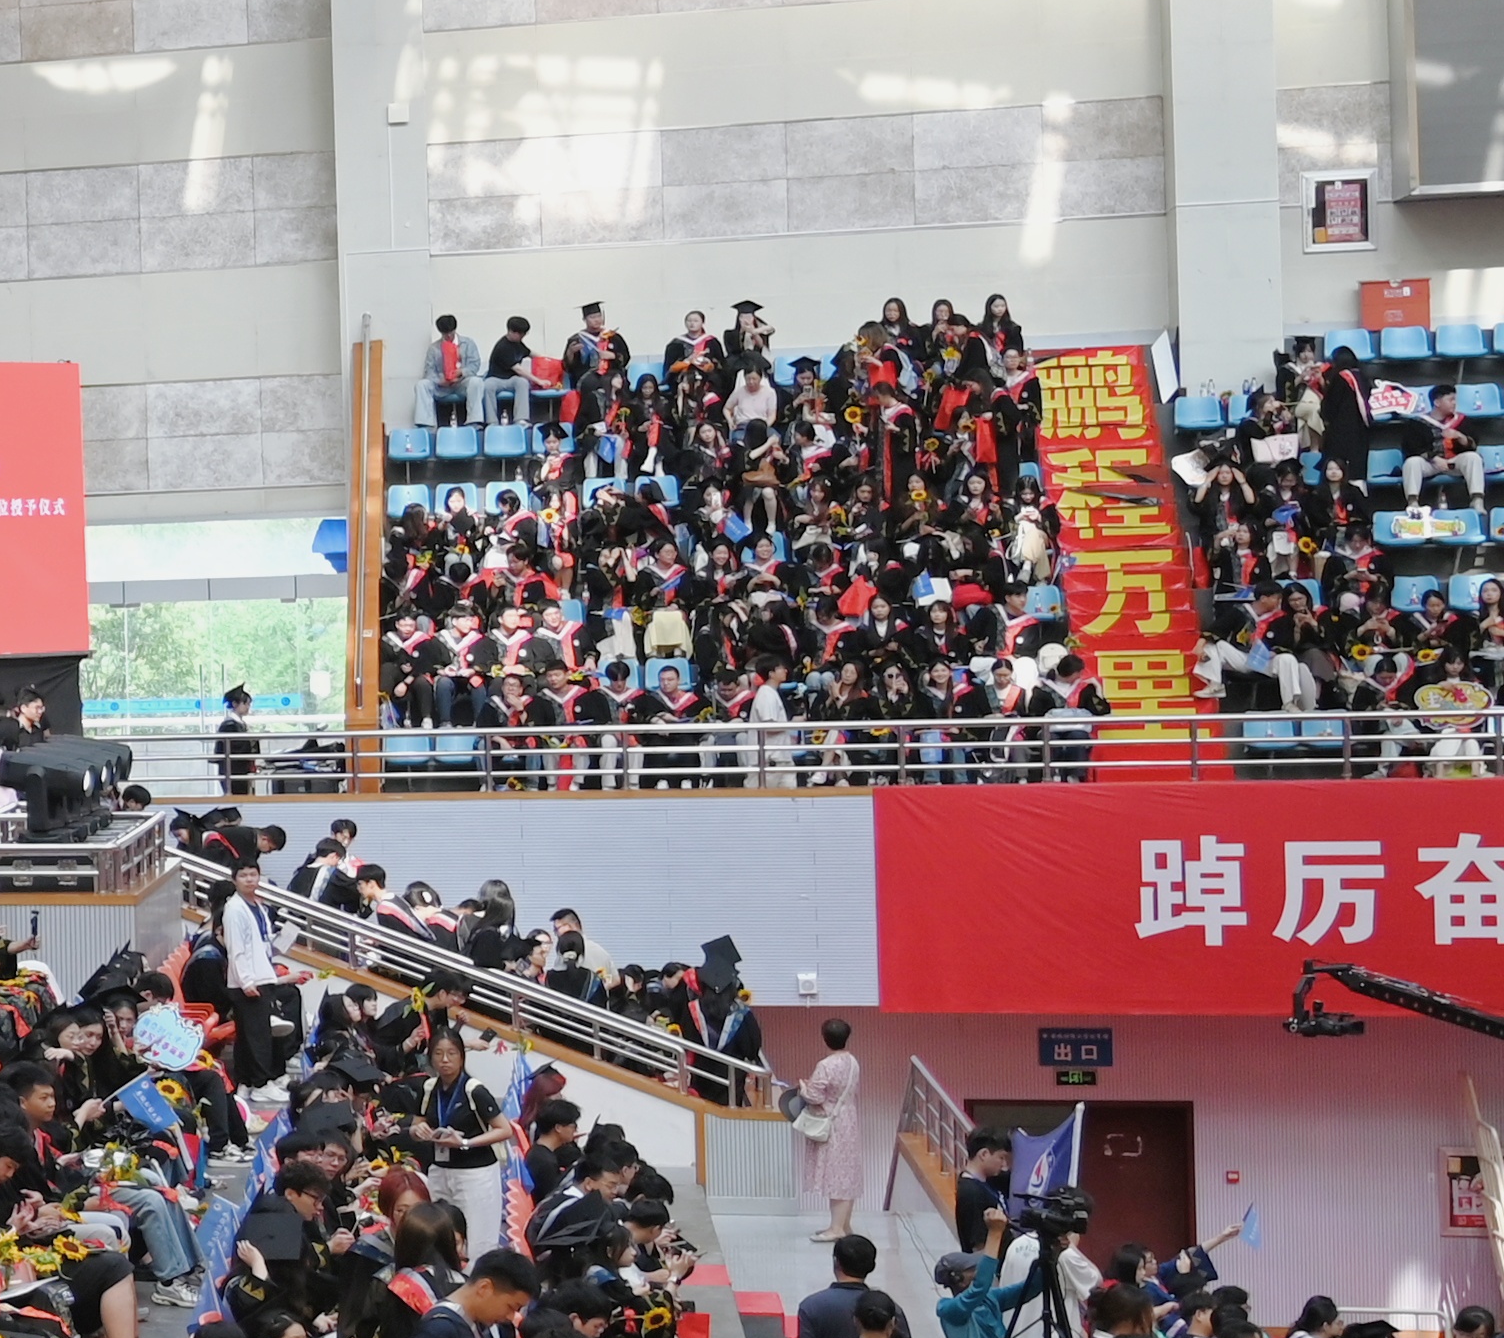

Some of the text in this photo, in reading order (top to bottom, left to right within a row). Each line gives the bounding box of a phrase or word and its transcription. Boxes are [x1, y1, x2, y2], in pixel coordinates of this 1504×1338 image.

[1034, 350, 1211, 741] 鹏程万里
[1053, 1043, 1098, 1061] 出口
